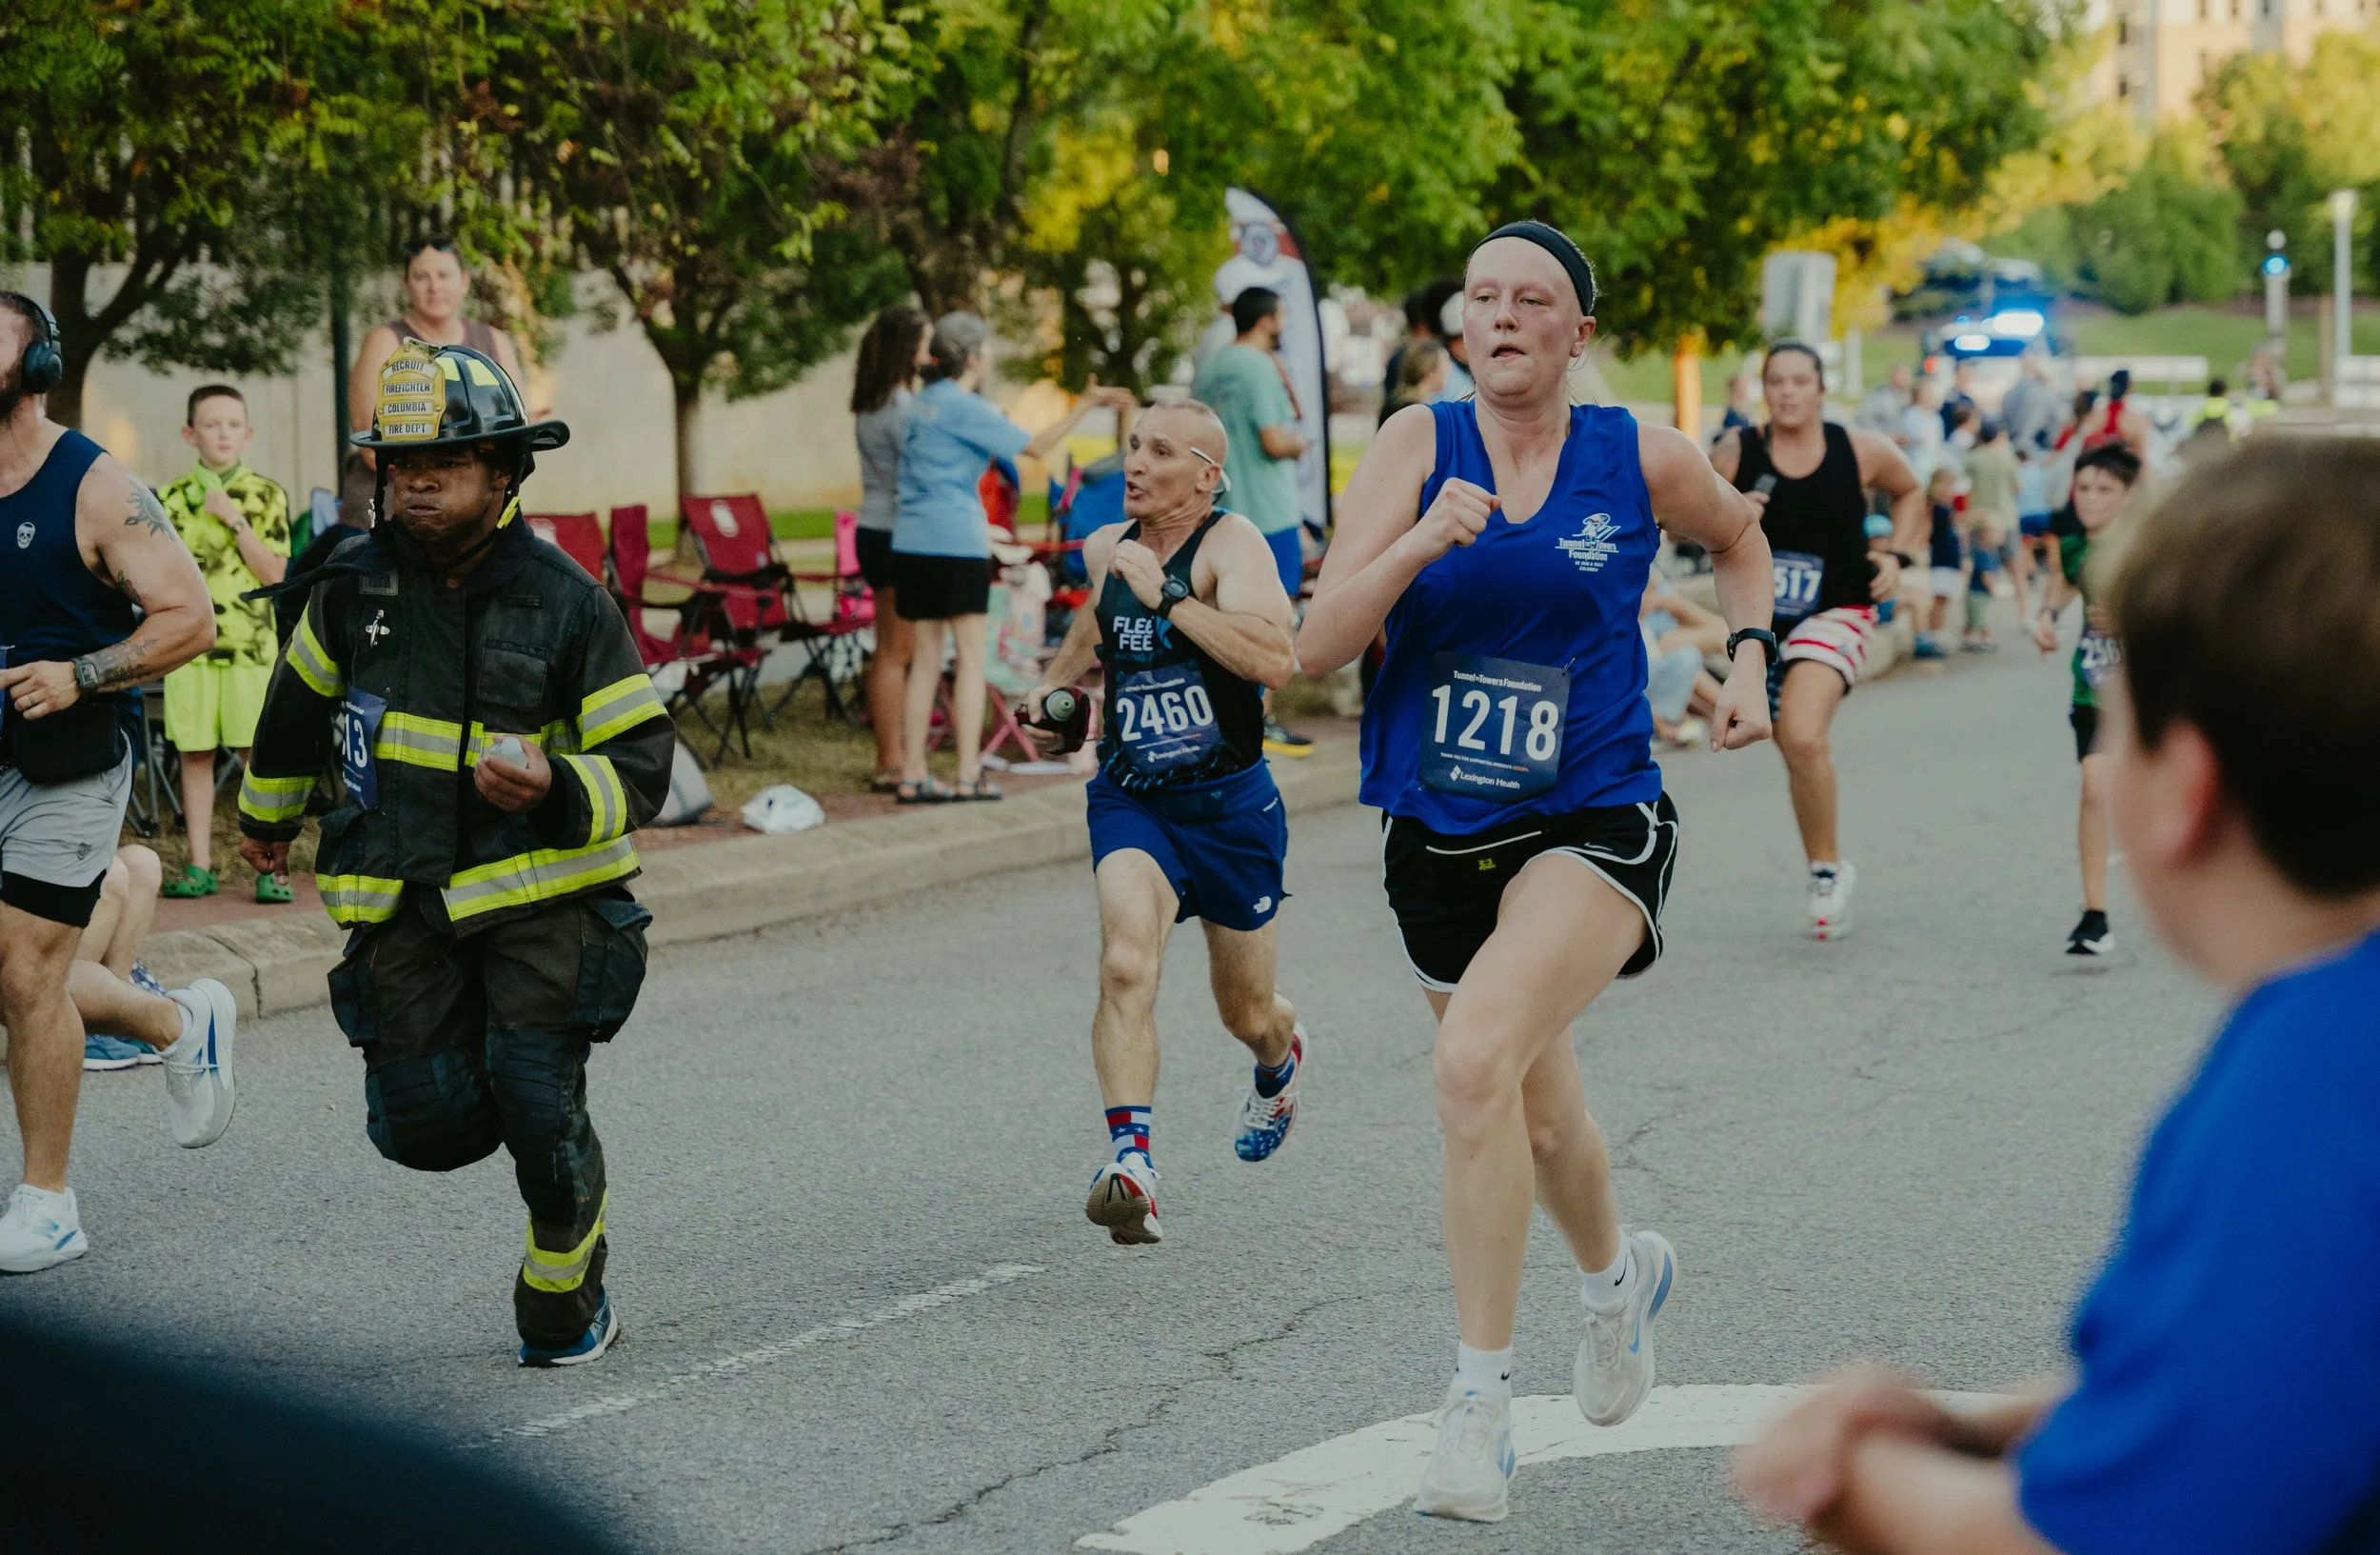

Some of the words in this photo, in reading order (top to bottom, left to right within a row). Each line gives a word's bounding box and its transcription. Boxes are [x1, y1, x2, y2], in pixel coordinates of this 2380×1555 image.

[391, 360, 425, 372] RECRUIT
[386, 383, 430, 393] FIREFIGHTER
[387, 403, 426, 413] COLUMBIA
[388, 424, 404, 434] FIRE
[405, 424, 426, 433] DEPT
[1558, 537, 1585, 548] Tunnel
[1568, 549, 1608, 561] Foundation
[1113, 615, 1155, 635] FLEE
[1454, 670, 1476, 682] Tunnel
[1479, 674, 1503, 687] Towers
[1503, 678, 1541, 692] Foundation
[1117, 685, 1214, 742] 2460
[1432, 685, 1558, 761] 1218
[343, 713, 367, 768] 13
[1460, 771, 1495, 785] Lexington
[1496, 778, 1520, 789] Health
